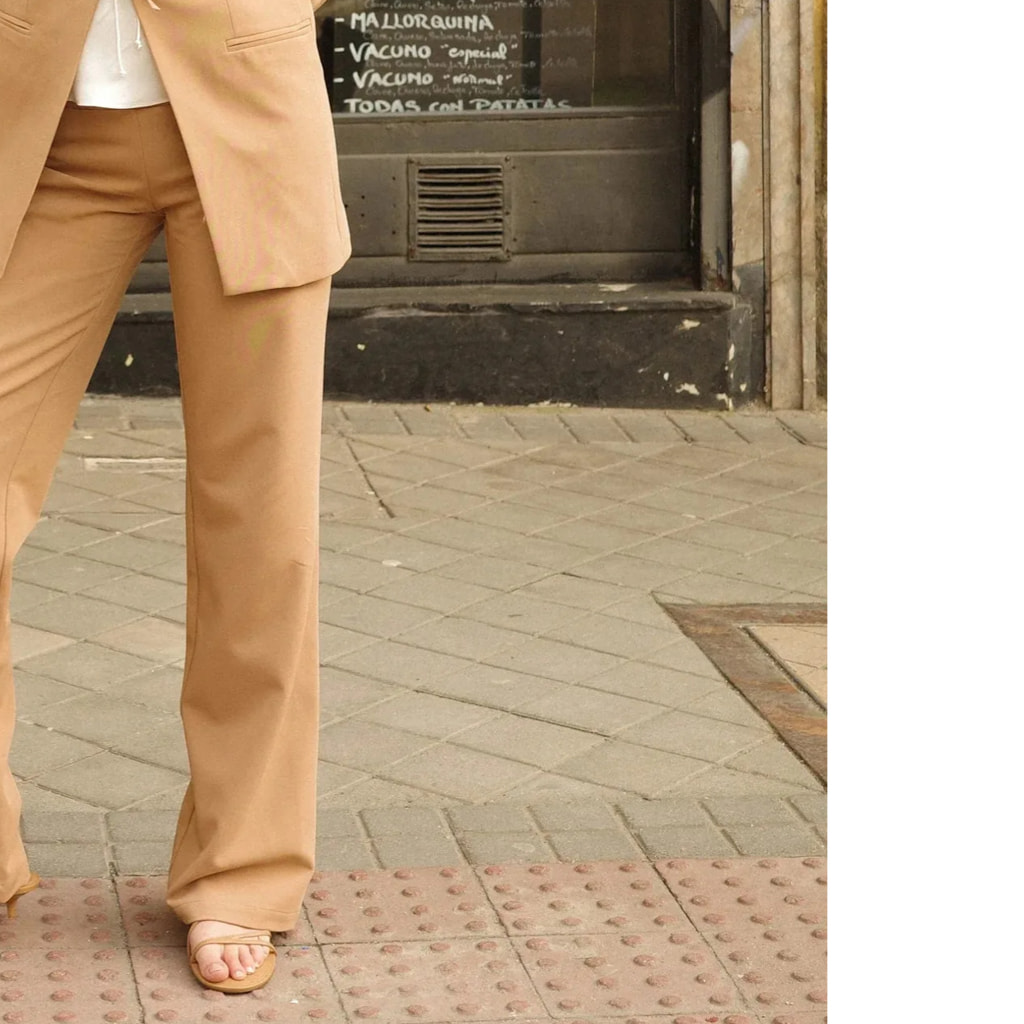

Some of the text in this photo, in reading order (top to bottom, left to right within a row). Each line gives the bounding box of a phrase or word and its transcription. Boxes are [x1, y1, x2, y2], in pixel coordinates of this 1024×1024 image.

[350, 12, 494, 33] MALLORQUINA
[349, 42, 432, 63] VACUNO
[352, 69, 434, 89] VACUNO
[343, 98, 422, 113] TODAS
